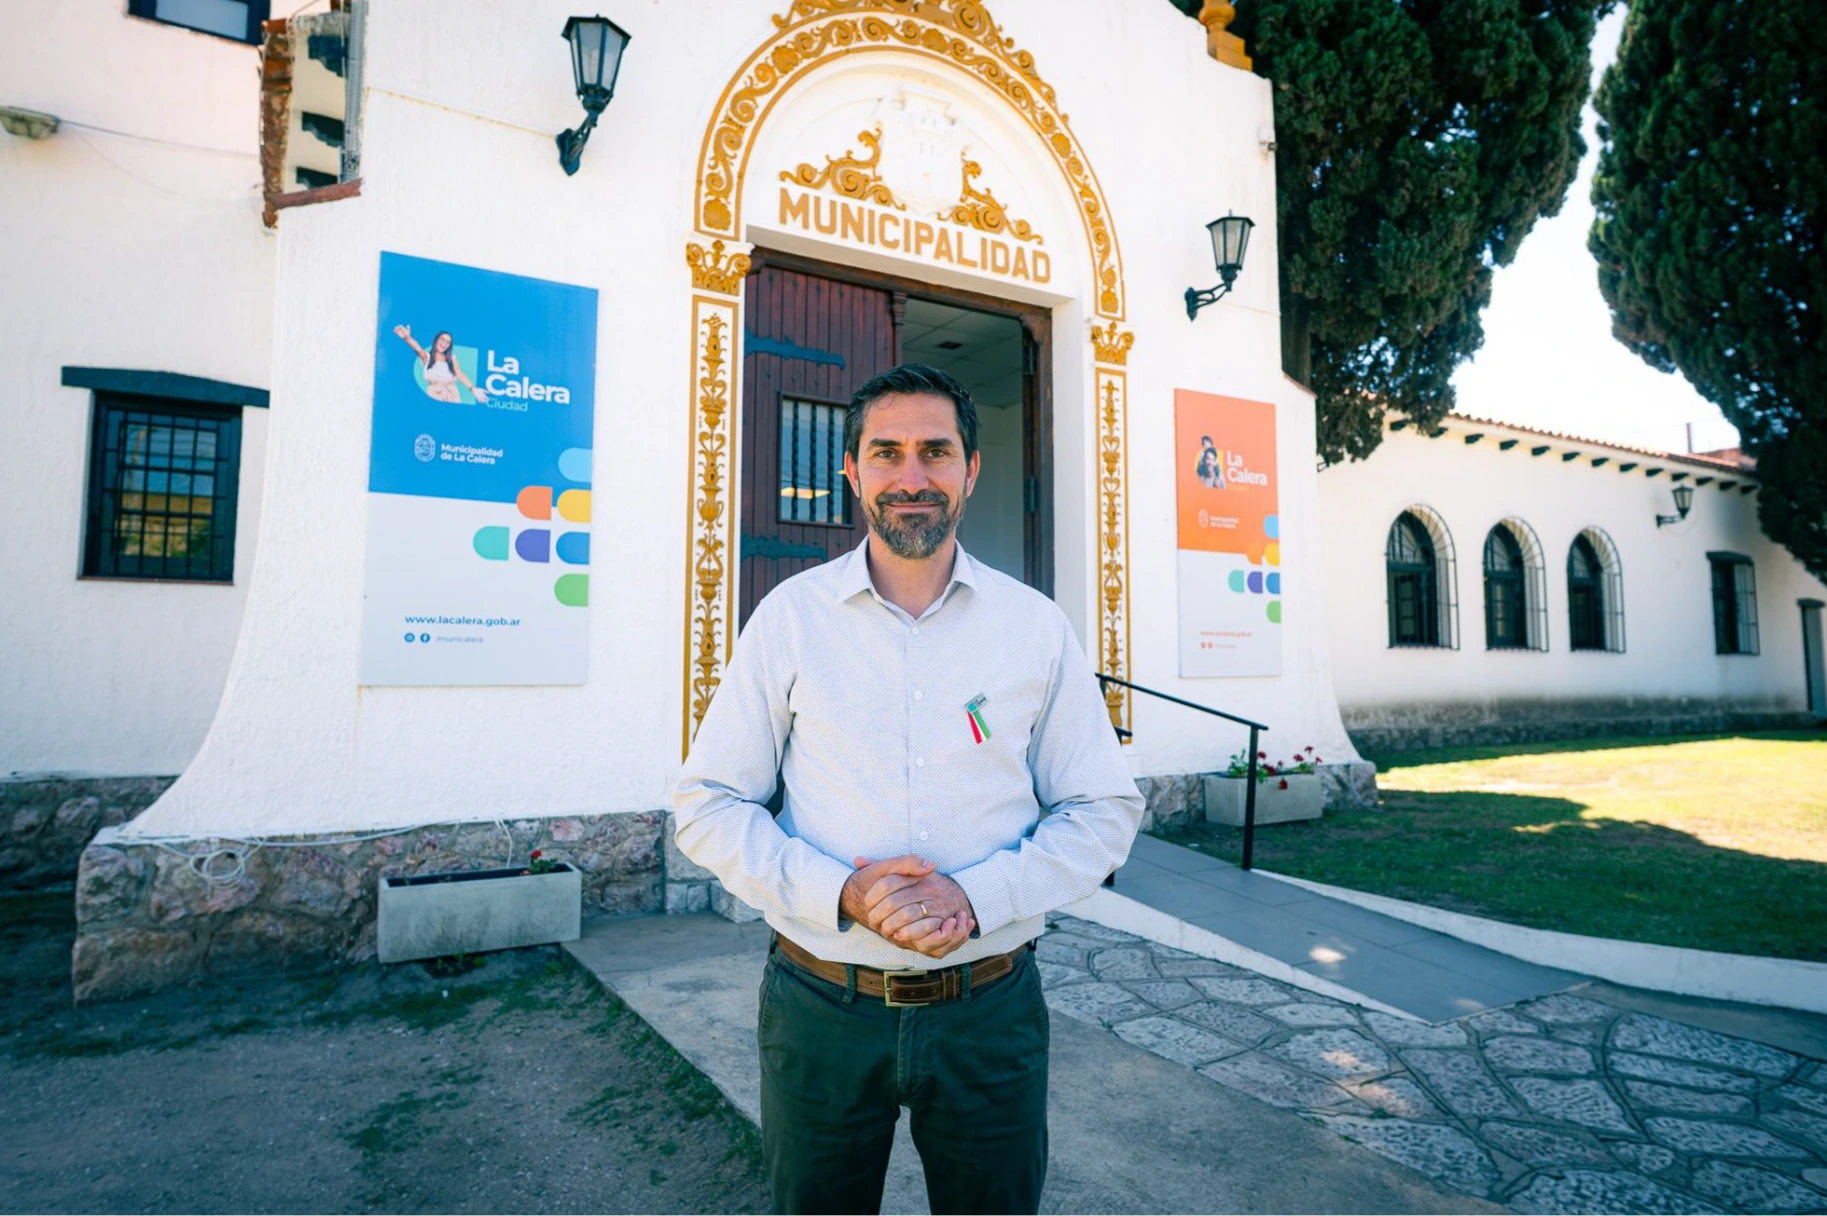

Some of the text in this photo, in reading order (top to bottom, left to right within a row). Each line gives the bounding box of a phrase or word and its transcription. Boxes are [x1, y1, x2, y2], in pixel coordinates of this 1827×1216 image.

[779, 187, 1051, 284] MUNICIPALIDAD
[487, 349, 519, 375] La
[485, 373, 570, 405] Calera
[486, 397, 528, 412] Ciudad
[440, 452, 496, 465] de La Calera
[441, 443, 503, 457] Municipalidad
[1227, 450, 1243, 467] La
[1226, 466, 1268, 486] Calera
[404, 615, 521, 627] www.lacalera.gob.ar
